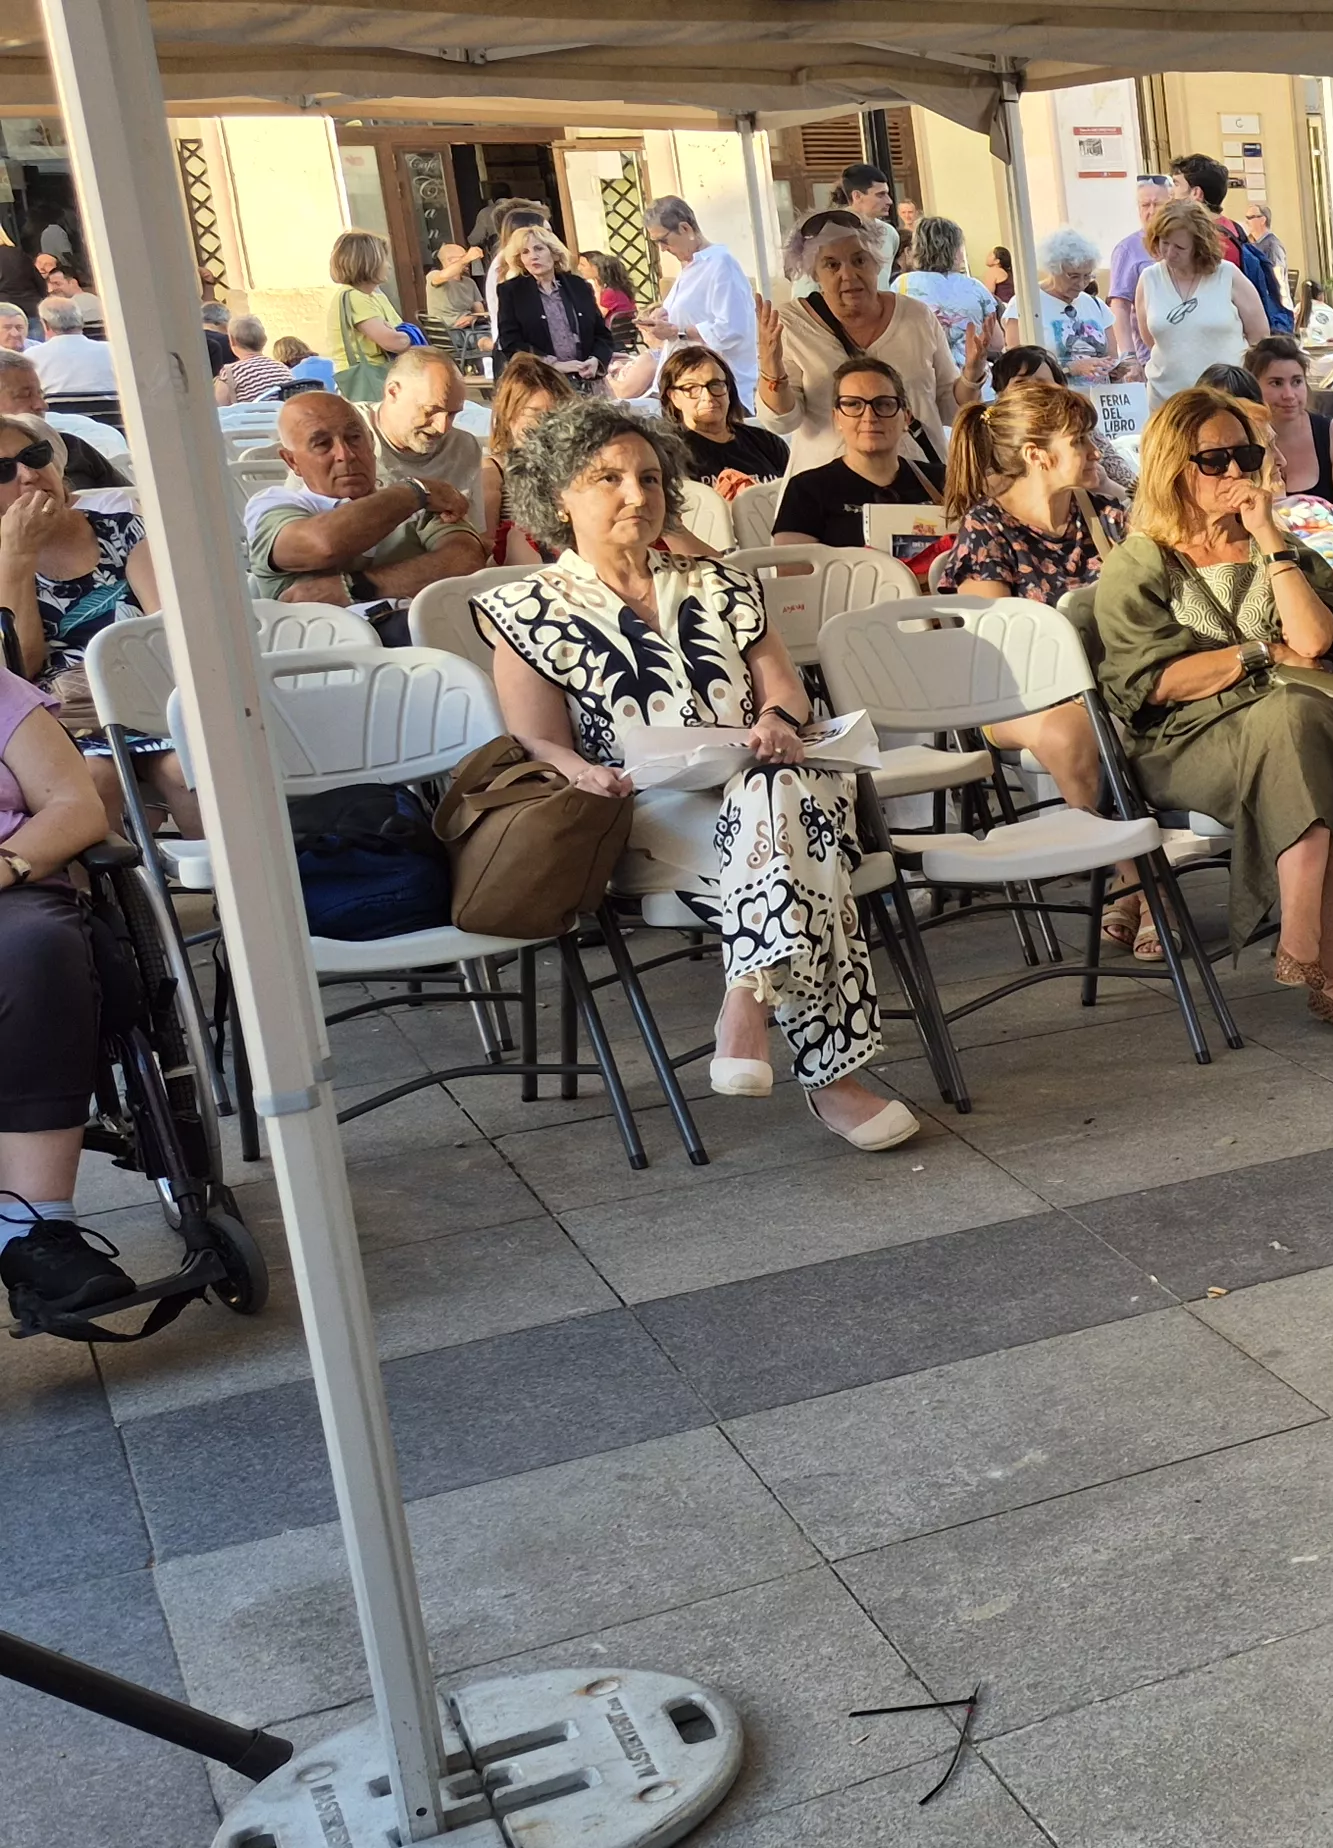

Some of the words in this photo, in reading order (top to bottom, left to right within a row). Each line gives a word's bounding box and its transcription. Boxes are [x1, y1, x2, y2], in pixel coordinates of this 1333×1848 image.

[1099, 393, 1131, 407] FERIA
[1102, 407, 1122, 420] DEL
[1104, 418, 1136, 433] LIBRO
